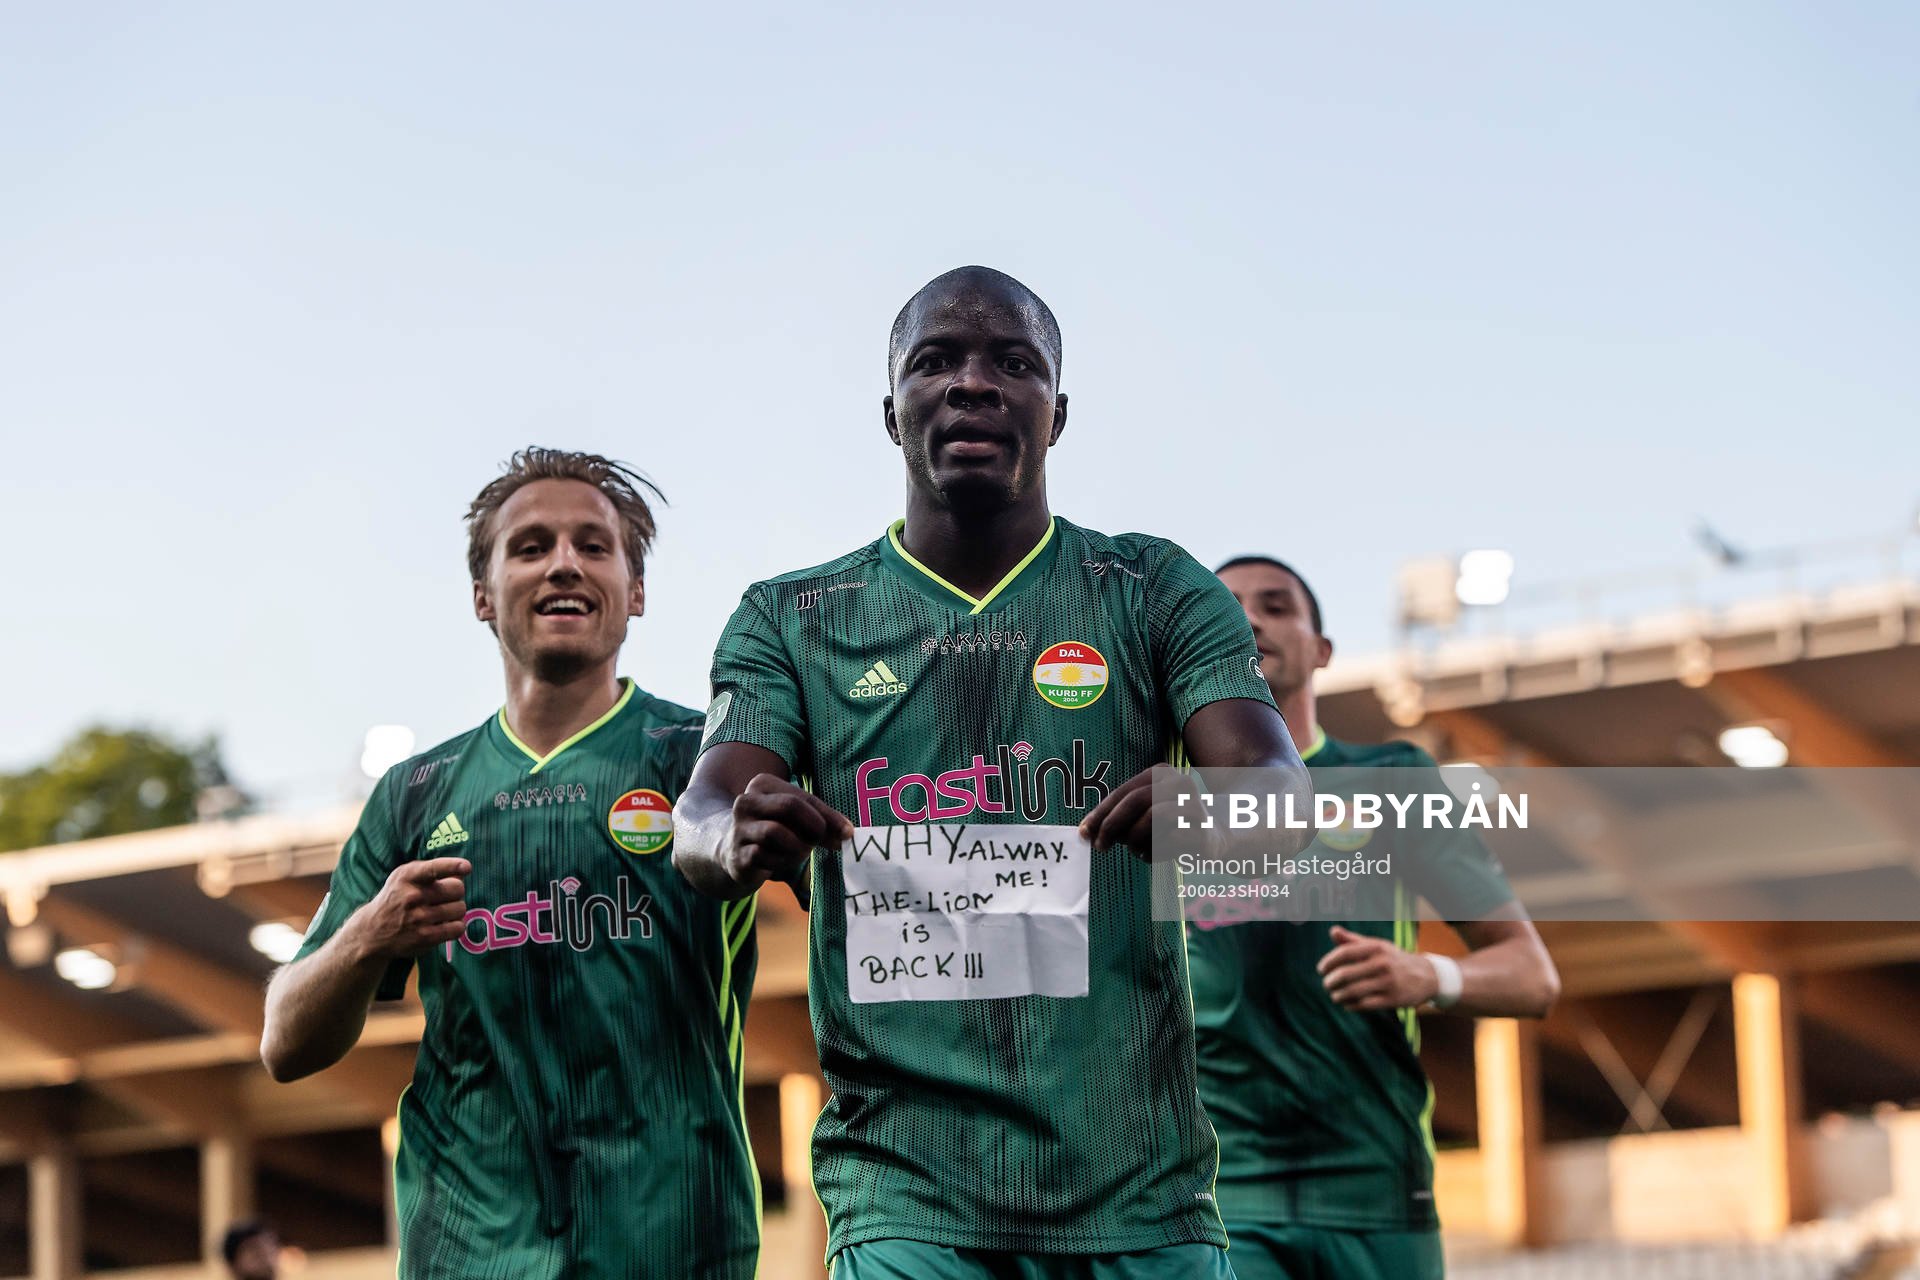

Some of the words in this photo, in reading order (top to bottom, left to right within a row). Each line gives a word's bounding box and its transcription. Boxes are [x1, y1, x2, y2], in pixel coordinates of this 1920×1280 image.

[941, 630, 1027, 649] AKACIA
[1058, 648, 1084, 658] DAL
[849, 679, 907, 698] adidas
[1048, 688, 1078, 697] KURD
[1080, 689, 1093, 698] FF
[631, 796, 654, 806] DAL
[426, 831, 469, 851] adidas
[445, 875, 652, 962] astlink
